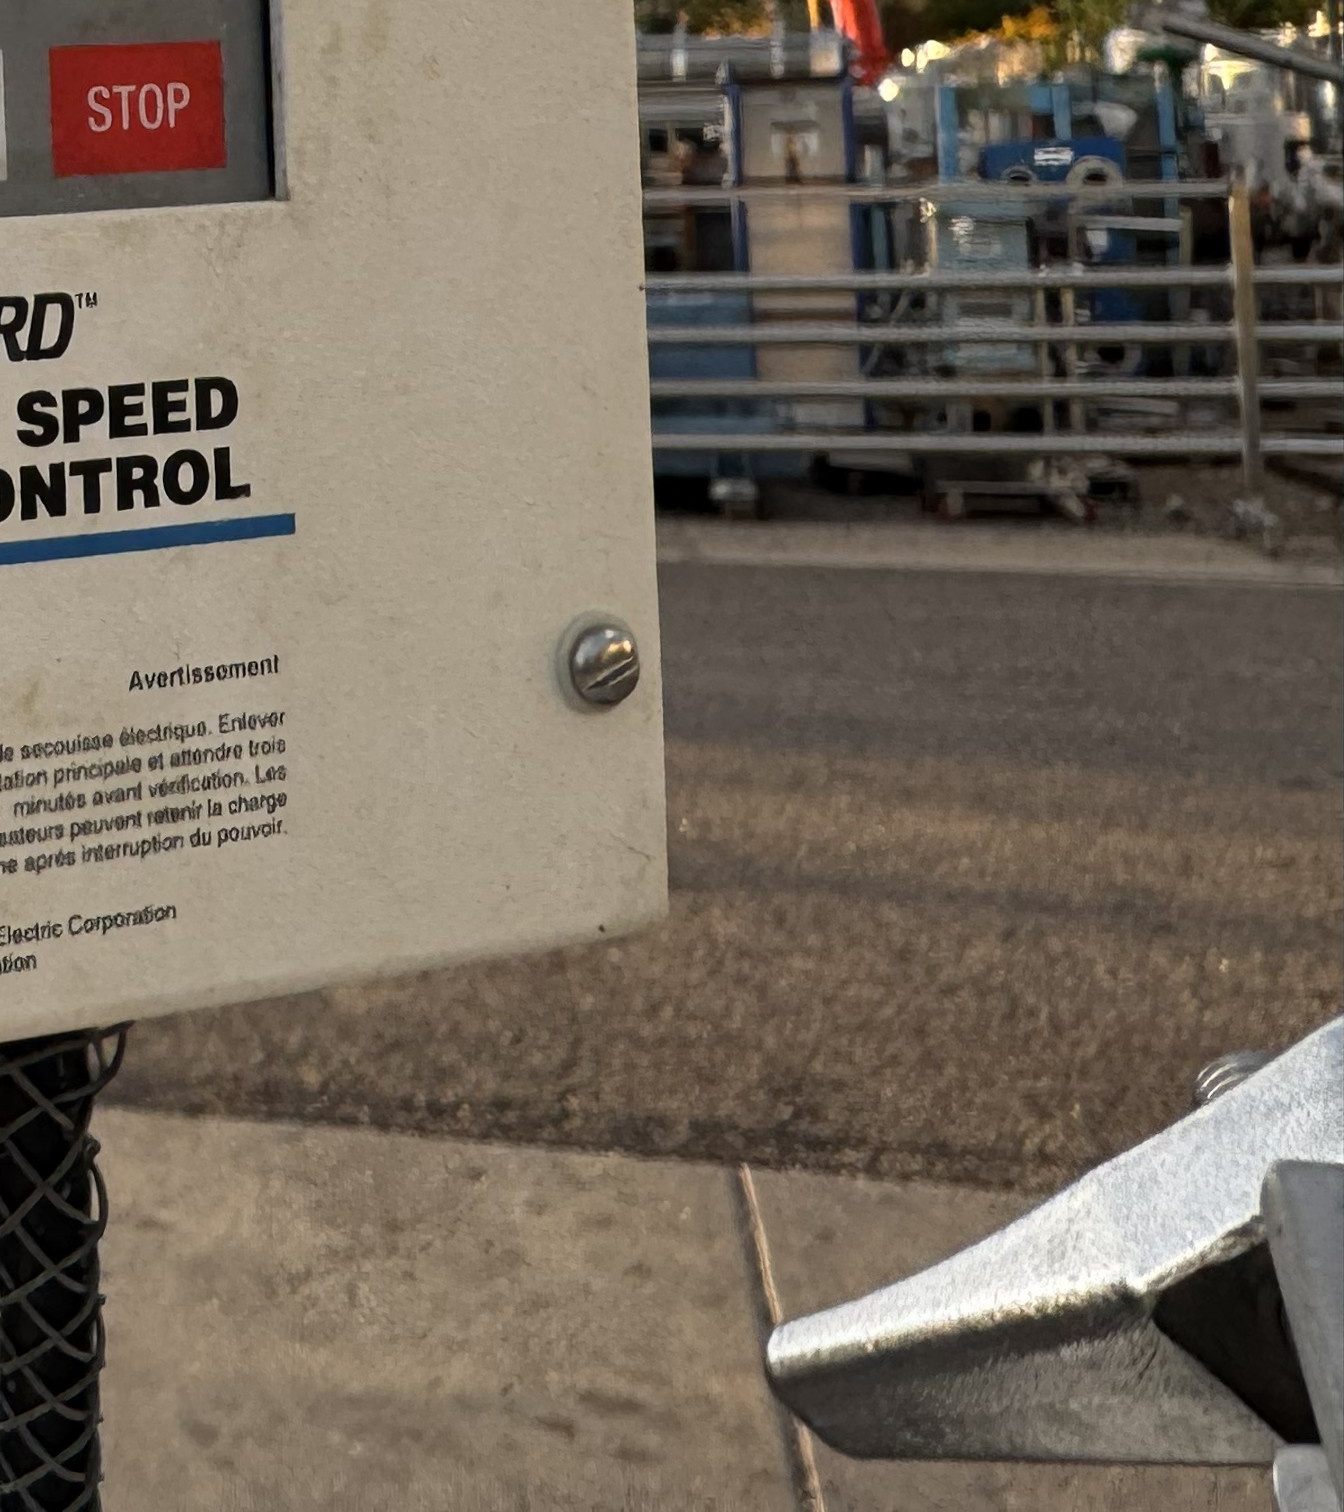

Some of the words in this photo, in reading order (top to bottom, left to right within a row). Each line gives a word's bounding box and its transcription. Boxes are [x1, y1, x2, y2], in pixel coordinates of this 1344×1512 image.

[85, 82, 190, 133] STOP
[16, 375, 240, 449] SPEED
[128, 654, 280, 693] Avertissement
[218, 710, 287, 735] Enlever
[147, 751, 165, 771] et
[248, 735, 287, 758] trois
[92, 781, 143, 807] avant
[207, 797, 223, 818] la
[228, 791, 289, 815] charge
[189, 827, 213, 849] du
[67, 903, 178, 937] Corporation
